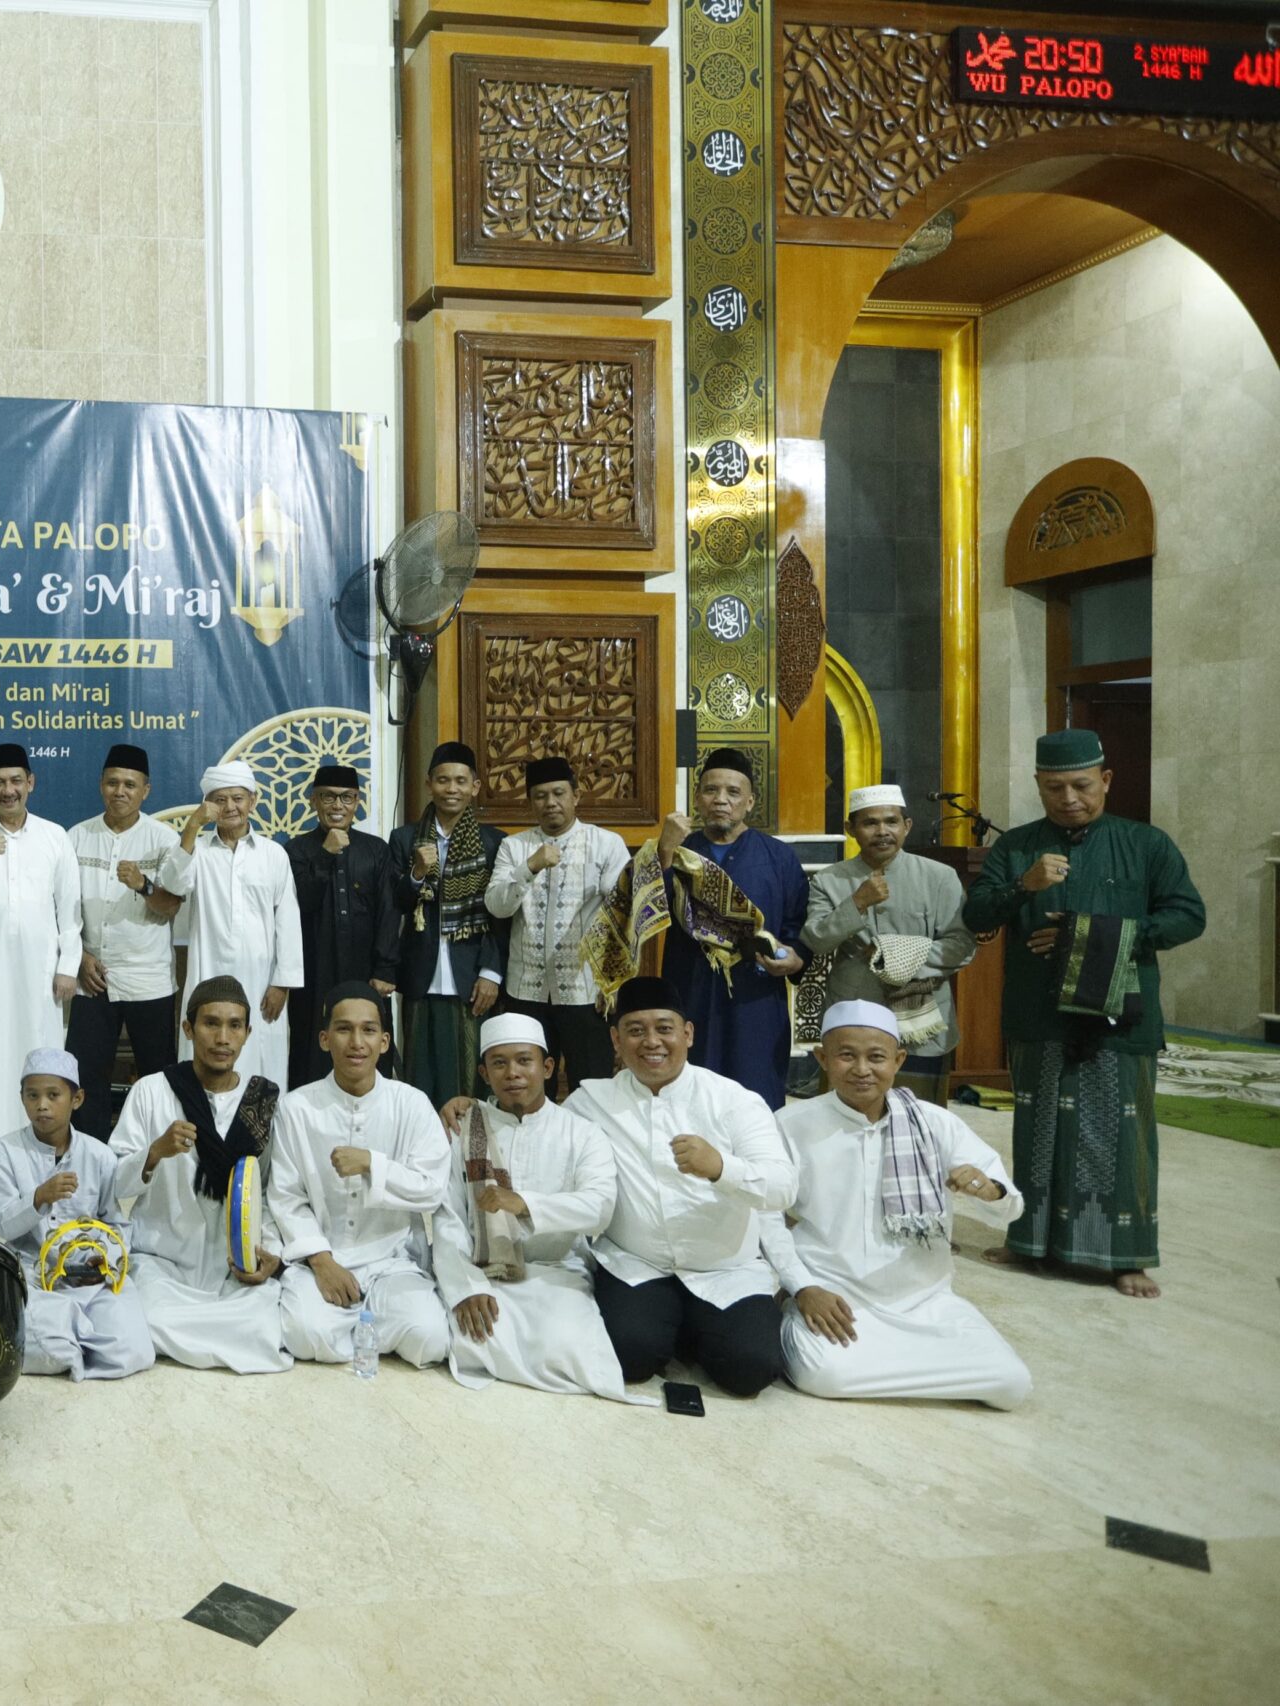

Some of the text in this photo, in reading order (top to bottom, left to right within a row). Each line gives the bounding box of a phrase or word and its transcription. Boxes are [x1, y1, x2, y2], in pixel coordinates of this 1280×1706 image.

[1024, 36, 1102, 74] 20:50
[1133, 43, 1144, 61] 2
[1142, 61, 1203, 80] 1446 H
[1020, 74, 1113, 100] PALOPO
[34, 521, 166, 551] PALOPO
[36, 573, 73, 615] &
[57, 643, 130, 665] 1446
[136, 643, 158, 665] H
[6, 682, 45, 702] dan
[52, 682, 110, 707] Mi'raj
[11, 710, 124, 730] Solidaritas
[130, 711, 186, 730] Umat
[29, 746, 71, 758] 1446 H
